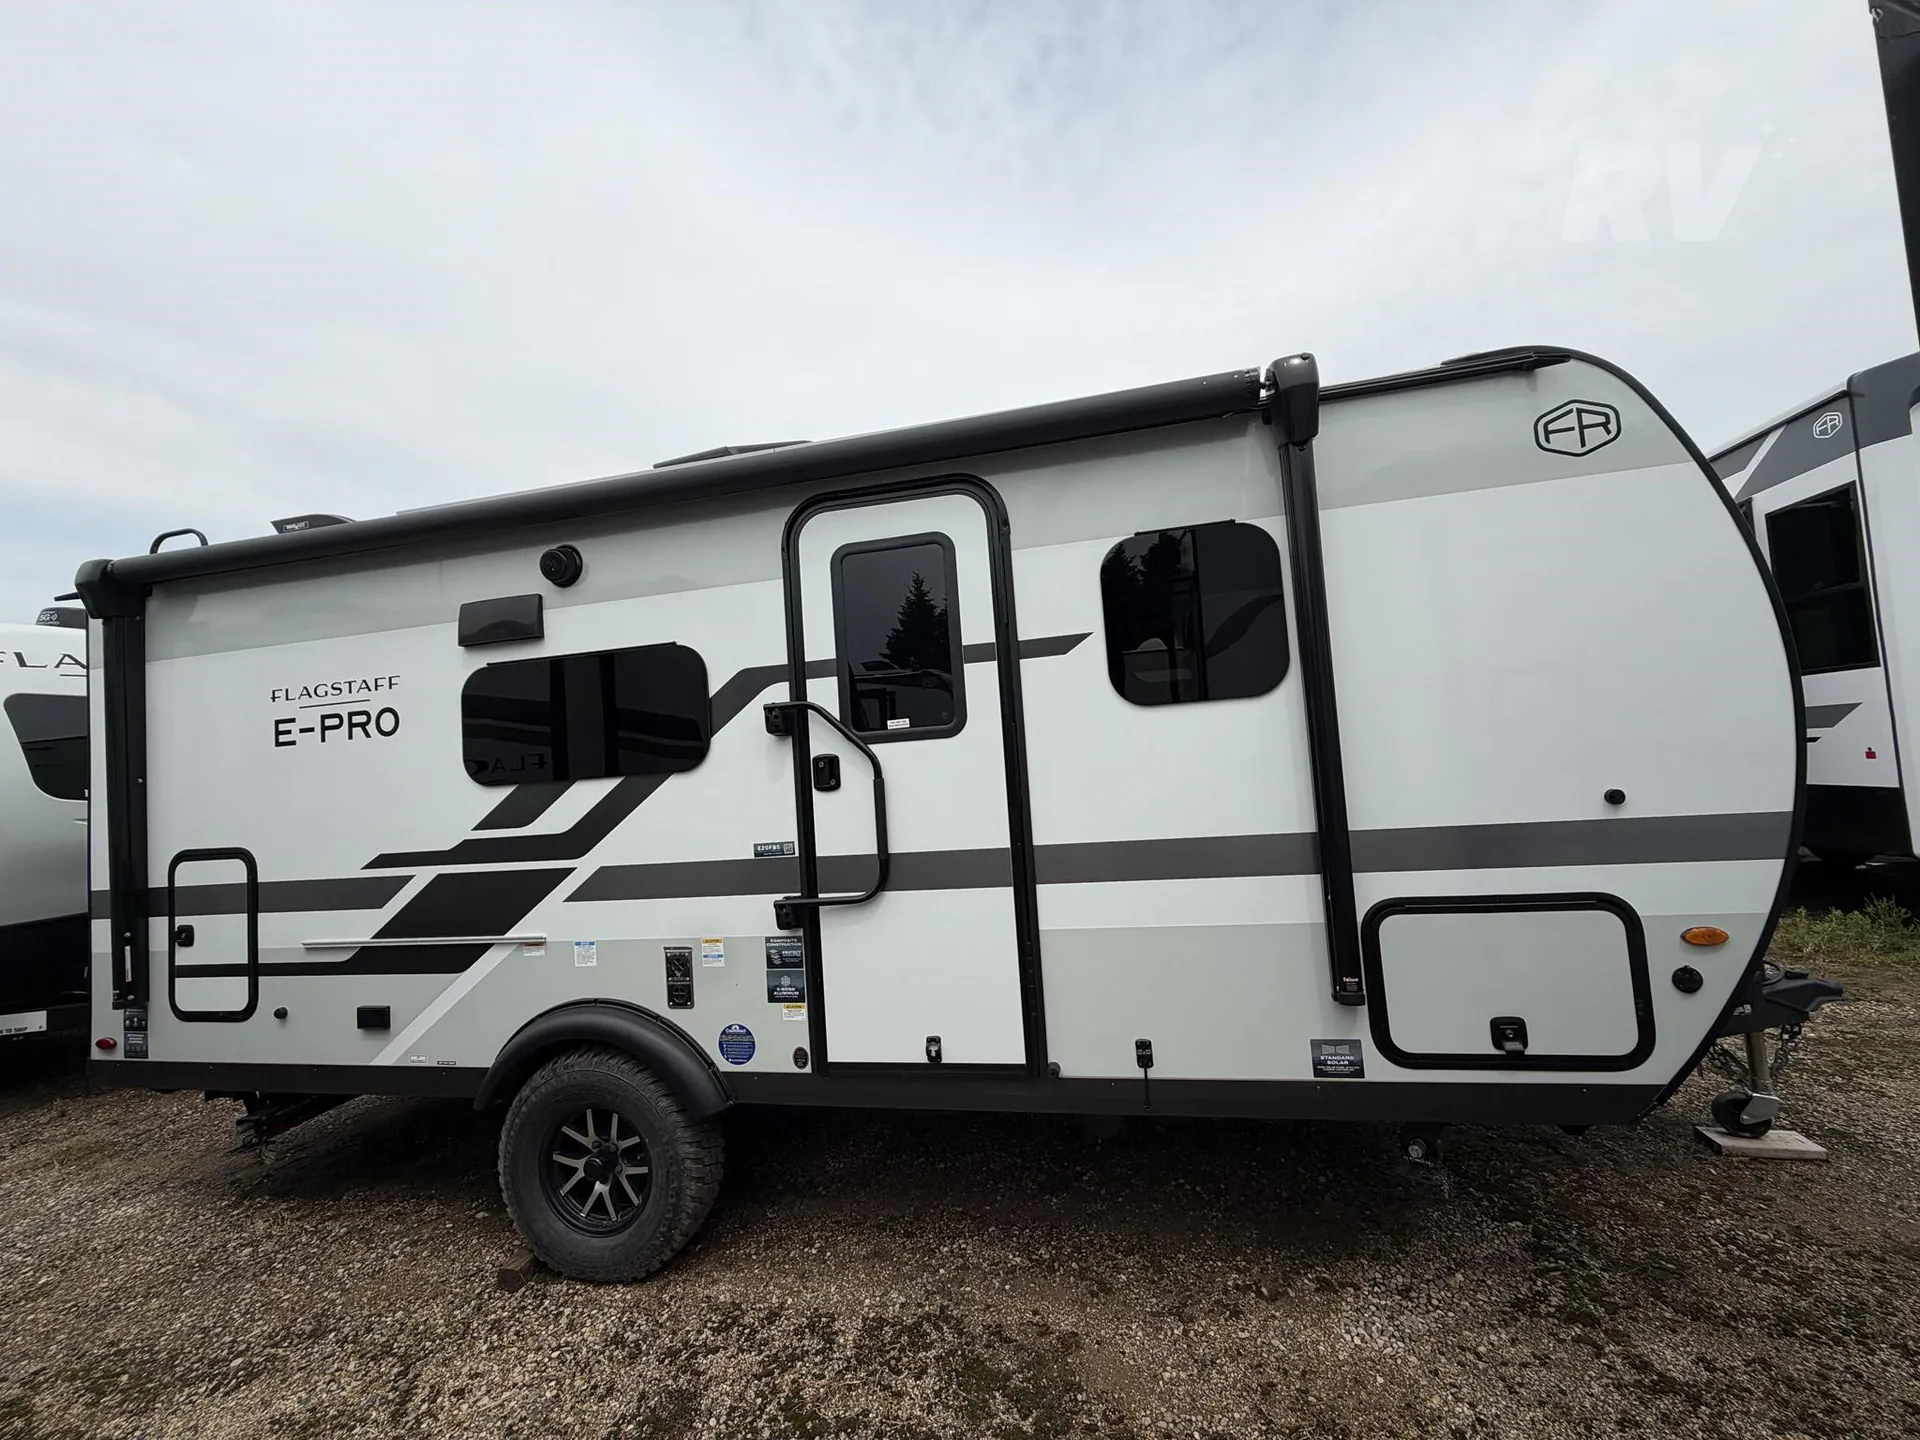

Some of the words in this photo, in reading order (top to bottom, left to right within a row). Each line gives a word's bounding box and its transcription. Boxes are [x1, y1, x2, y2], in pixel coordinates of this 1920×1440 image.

[0, 651, 87, 670] LA
[270, 675, 400, 702] FLAGSTAFF
[274, 706, 400, 747] E-PRO
